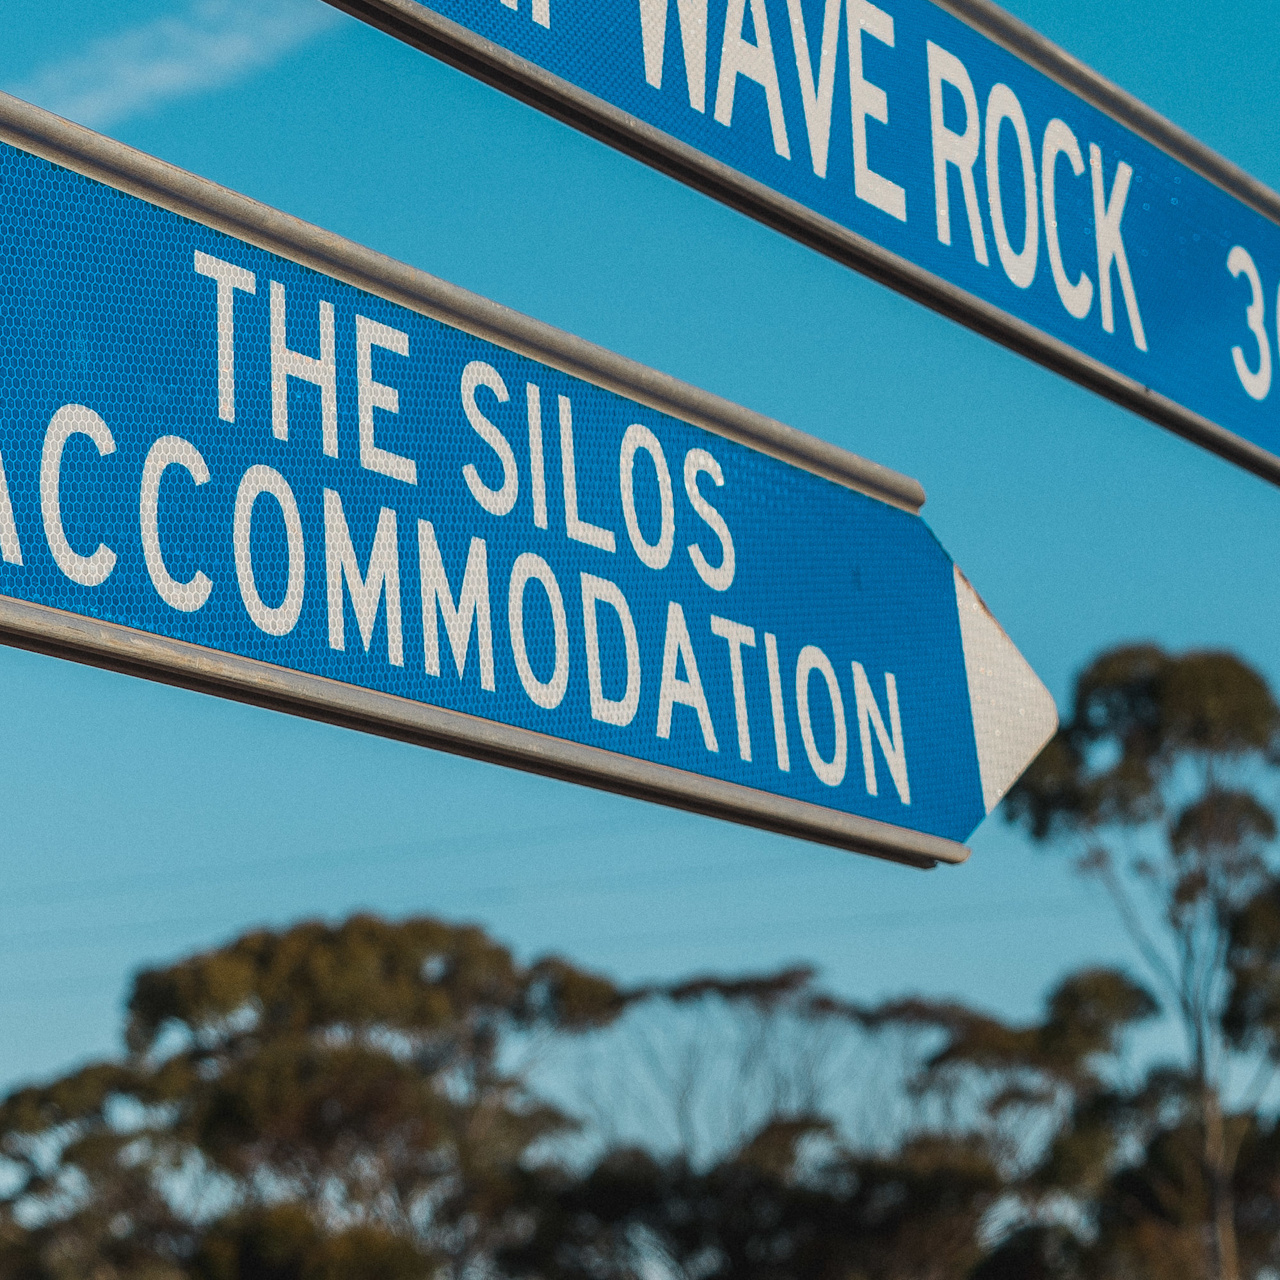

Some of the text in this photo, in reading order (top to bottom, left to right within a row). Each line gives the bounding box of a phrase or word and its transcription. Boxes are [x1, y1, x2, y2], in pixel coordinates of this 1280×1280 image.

[927, 39, 1148, 352] ROCK
[193, 250, 737, 592] THE SILOS
